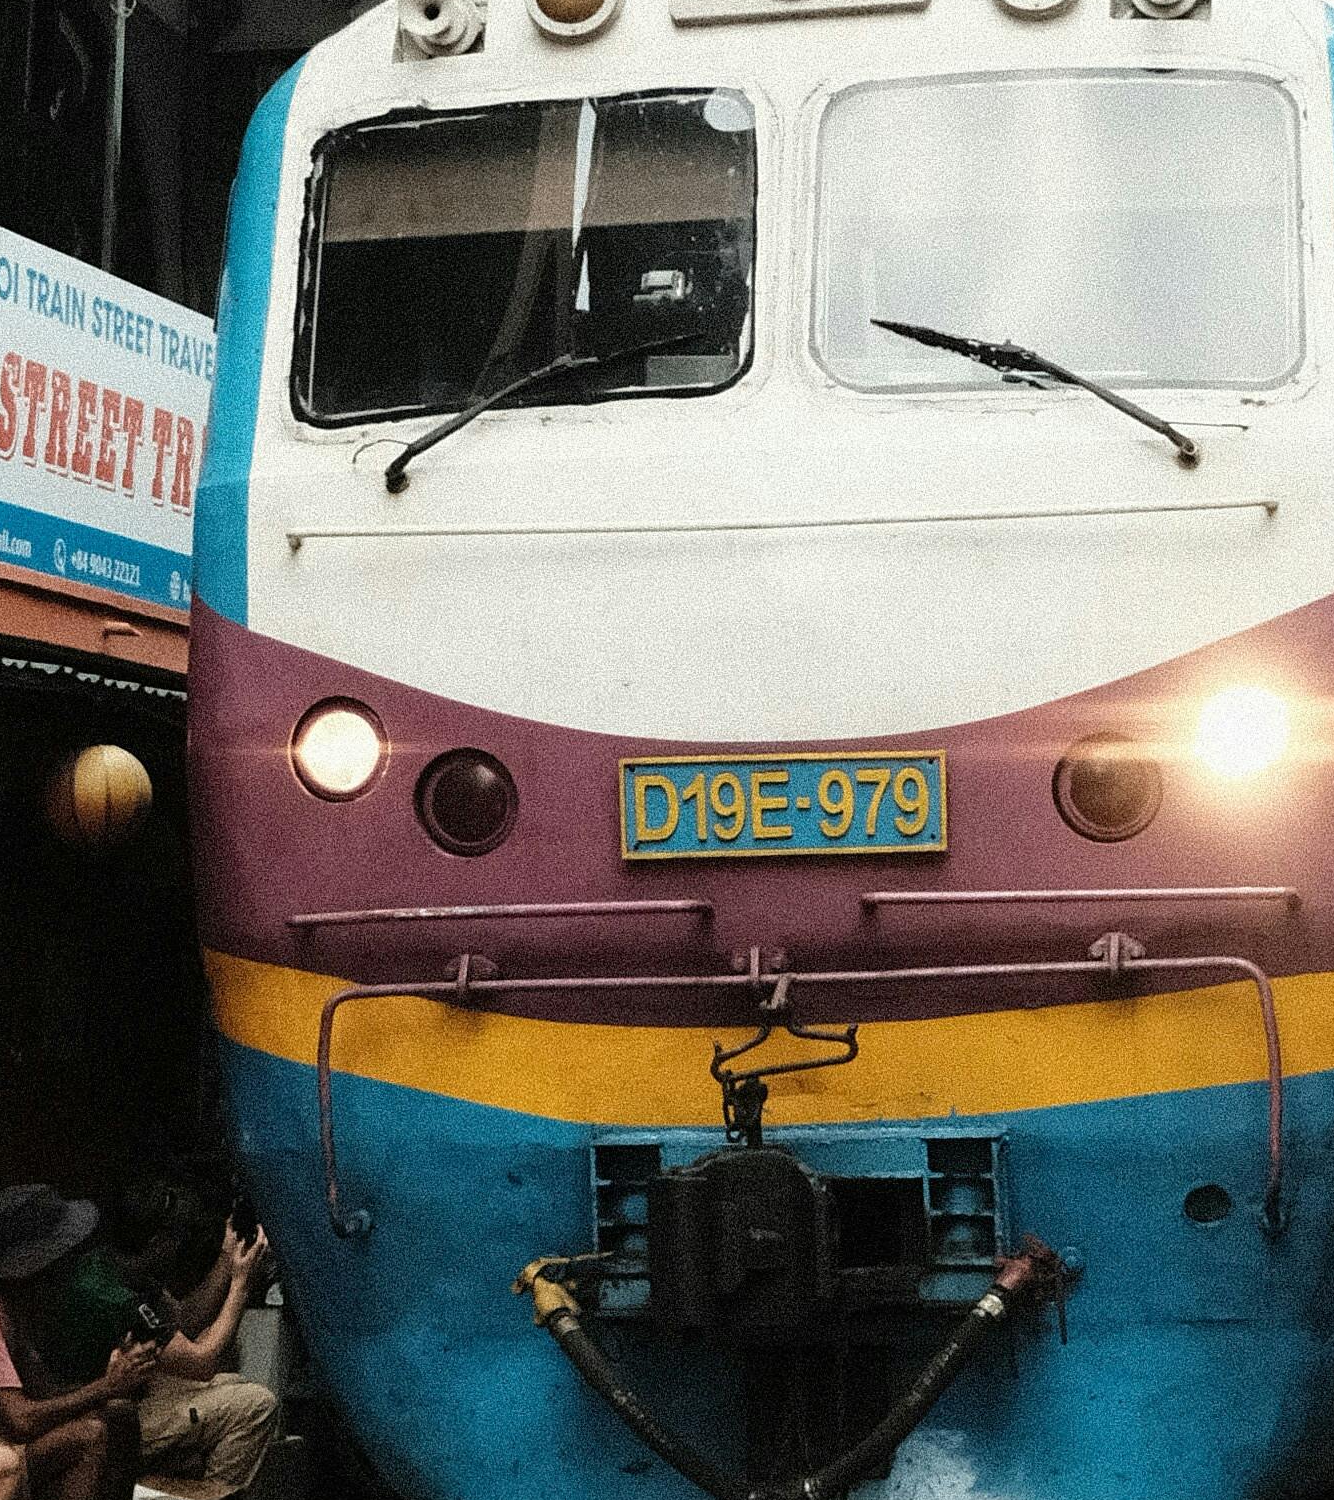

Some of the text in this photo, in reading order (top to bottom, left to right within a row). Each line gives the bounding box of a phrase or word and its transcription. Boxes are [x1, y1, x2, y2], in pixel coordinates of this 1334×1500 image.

[26, 267, 86, 331] TRAIN
[91, 296, 154, 357] STREET
[152, 407, 207, 513] TR
[634, 767, 930, 842] D19E-979
